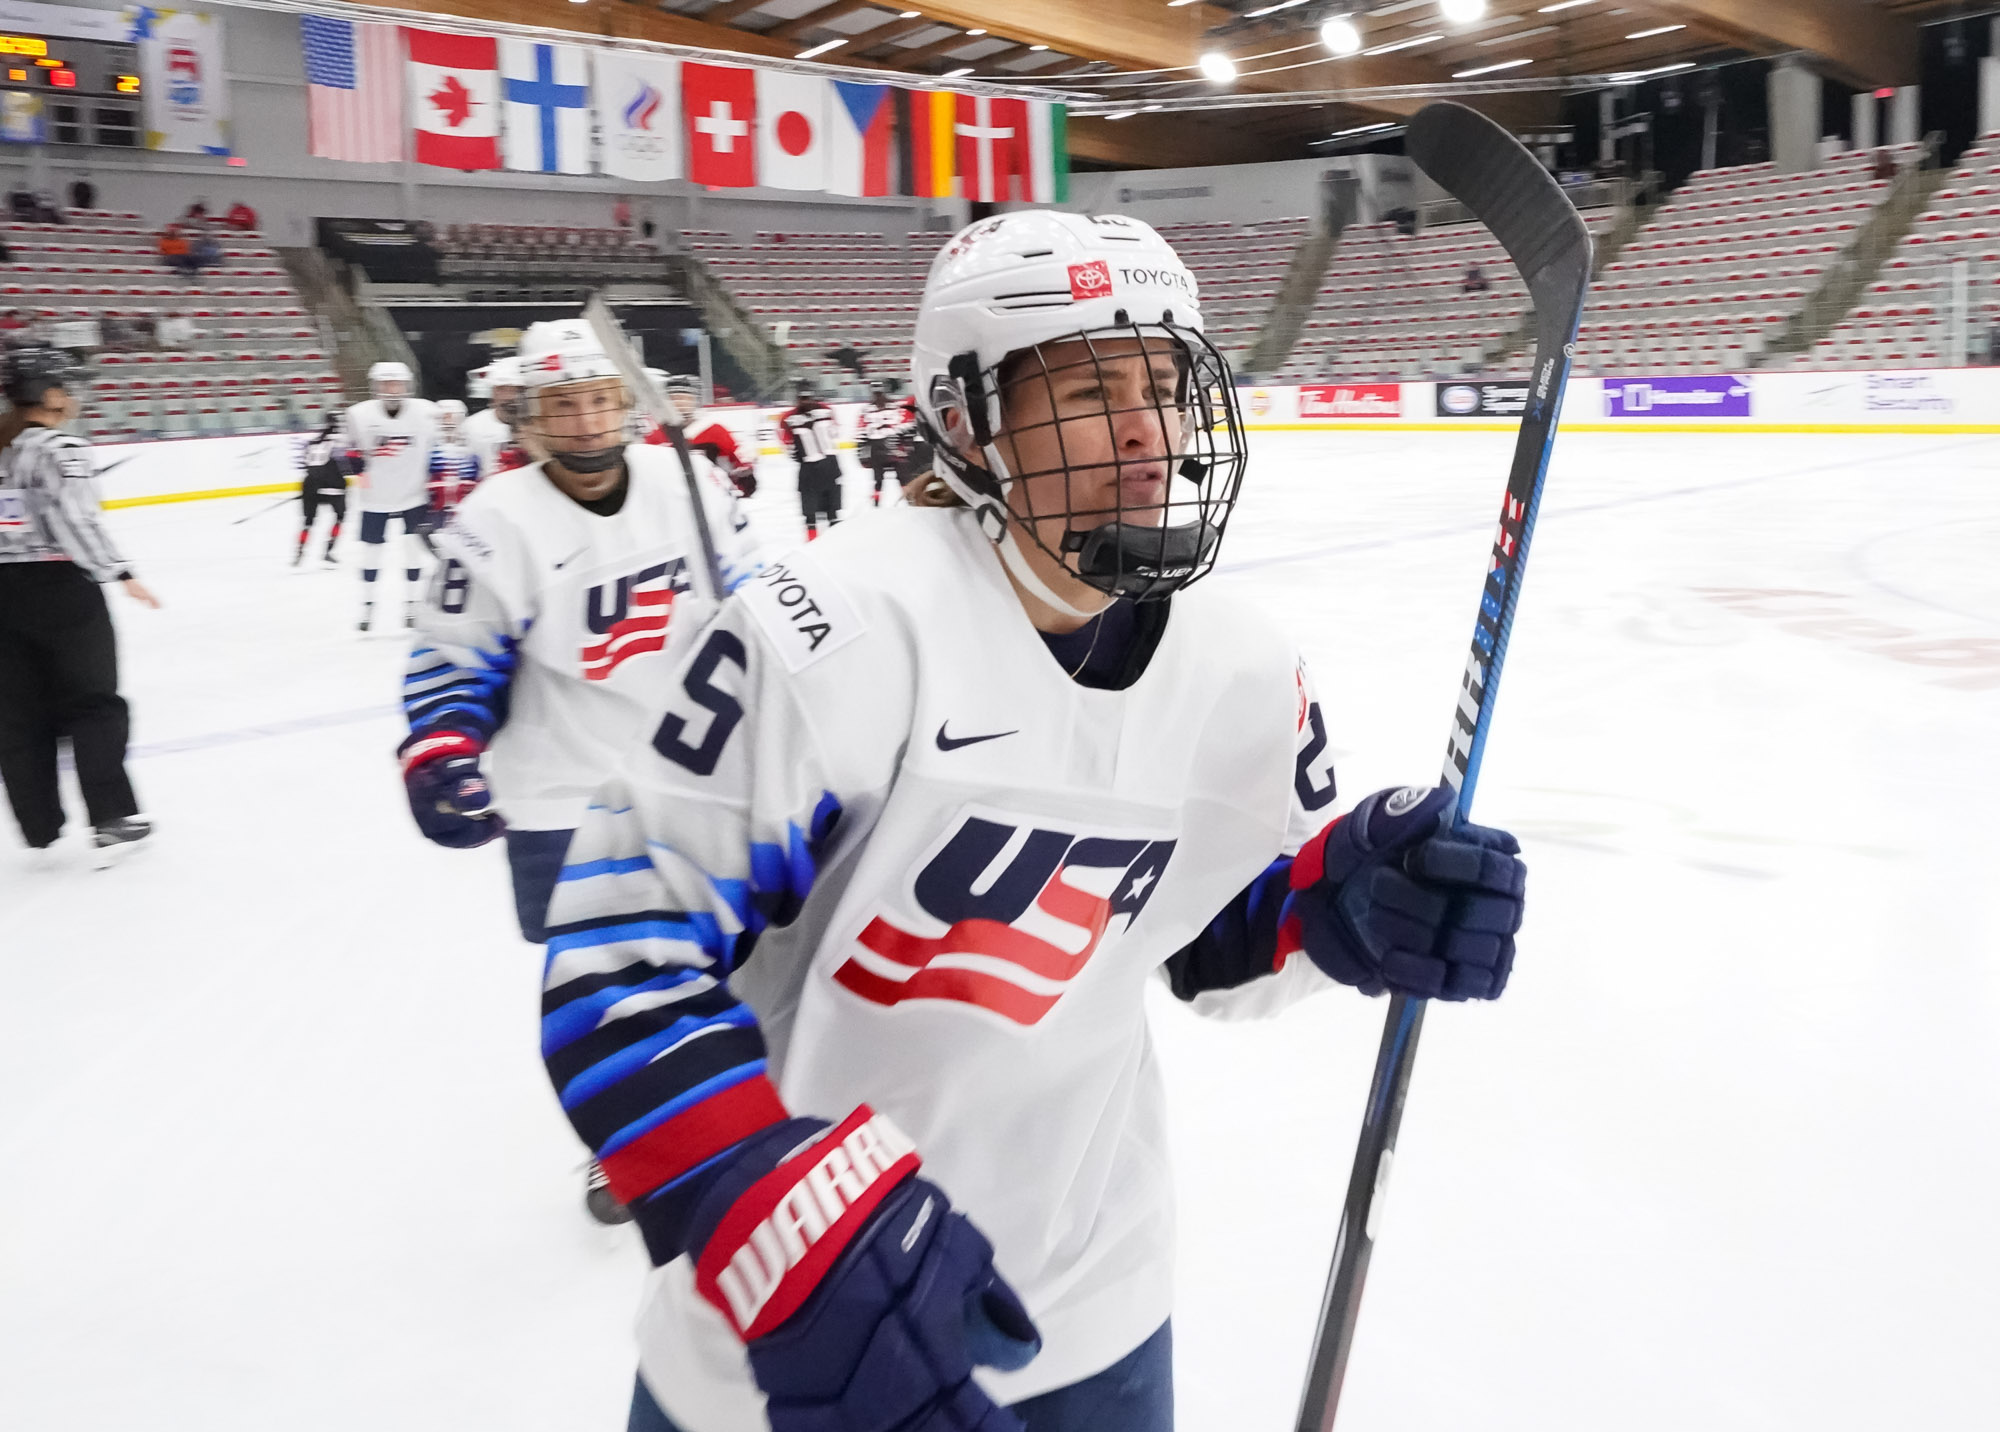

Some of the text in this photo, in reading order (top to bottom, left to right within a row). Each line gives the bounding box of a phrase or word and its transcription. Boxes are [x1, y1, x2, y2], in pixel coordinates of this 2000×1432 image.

[1118, 268, 1189, 292] TOYOTA
[758, 563, 832, 653] OYOTA
[652, 629, 748, 776] 5
[1294, 701, 1338, 812] 2
[914, 816, 1178, 982] USA
